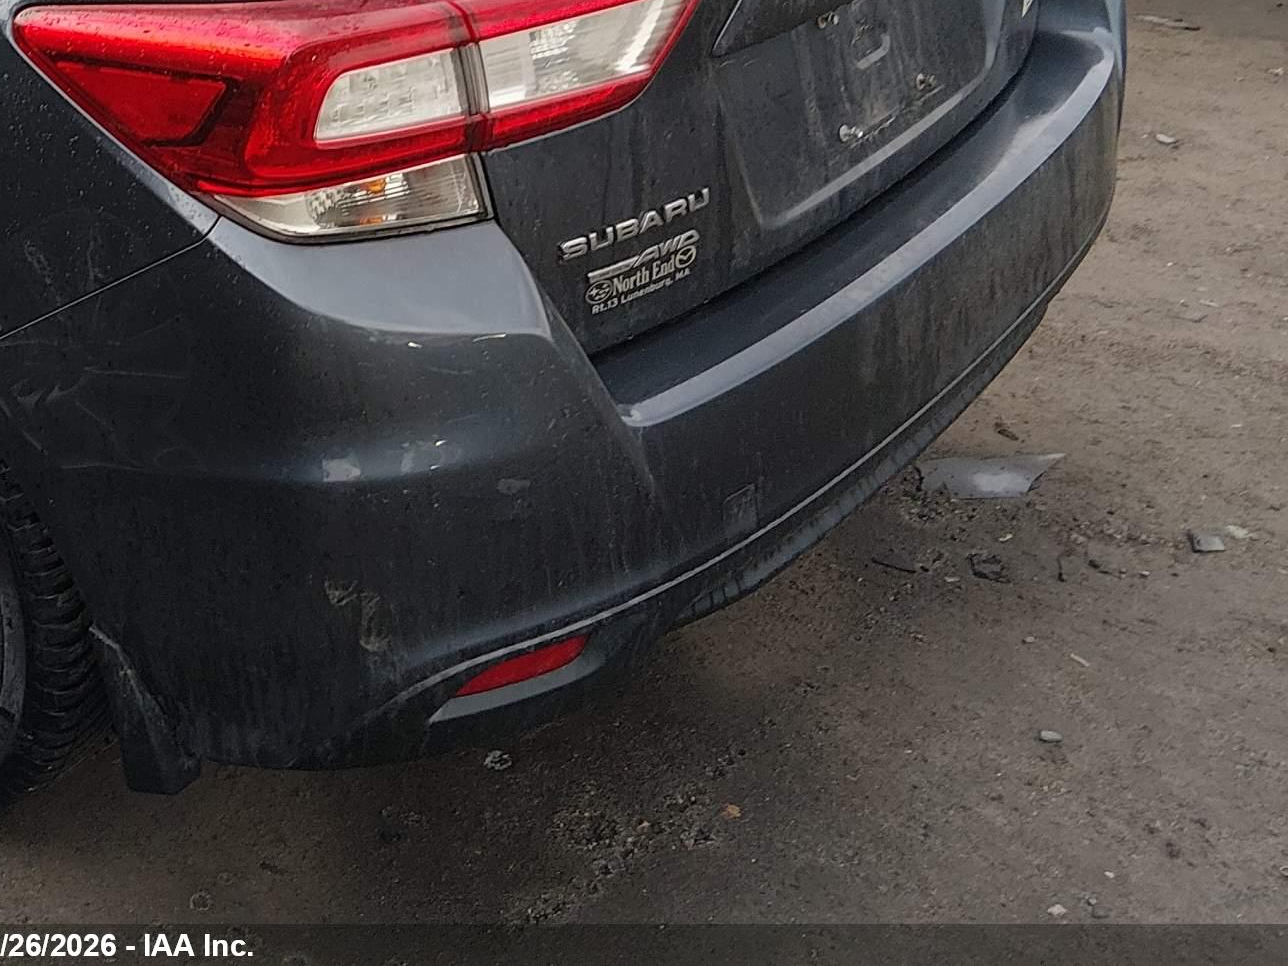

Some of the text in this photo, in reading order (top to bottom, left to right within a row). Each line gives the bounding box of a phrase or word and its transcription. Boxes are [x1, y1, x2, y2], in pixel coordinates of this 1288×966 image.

[559, 187, 710, 262] SUBARU
[632, 229, 700, 268] AWD
[612, 268, 650, 296] North
[652, 255, 676, 280] End
